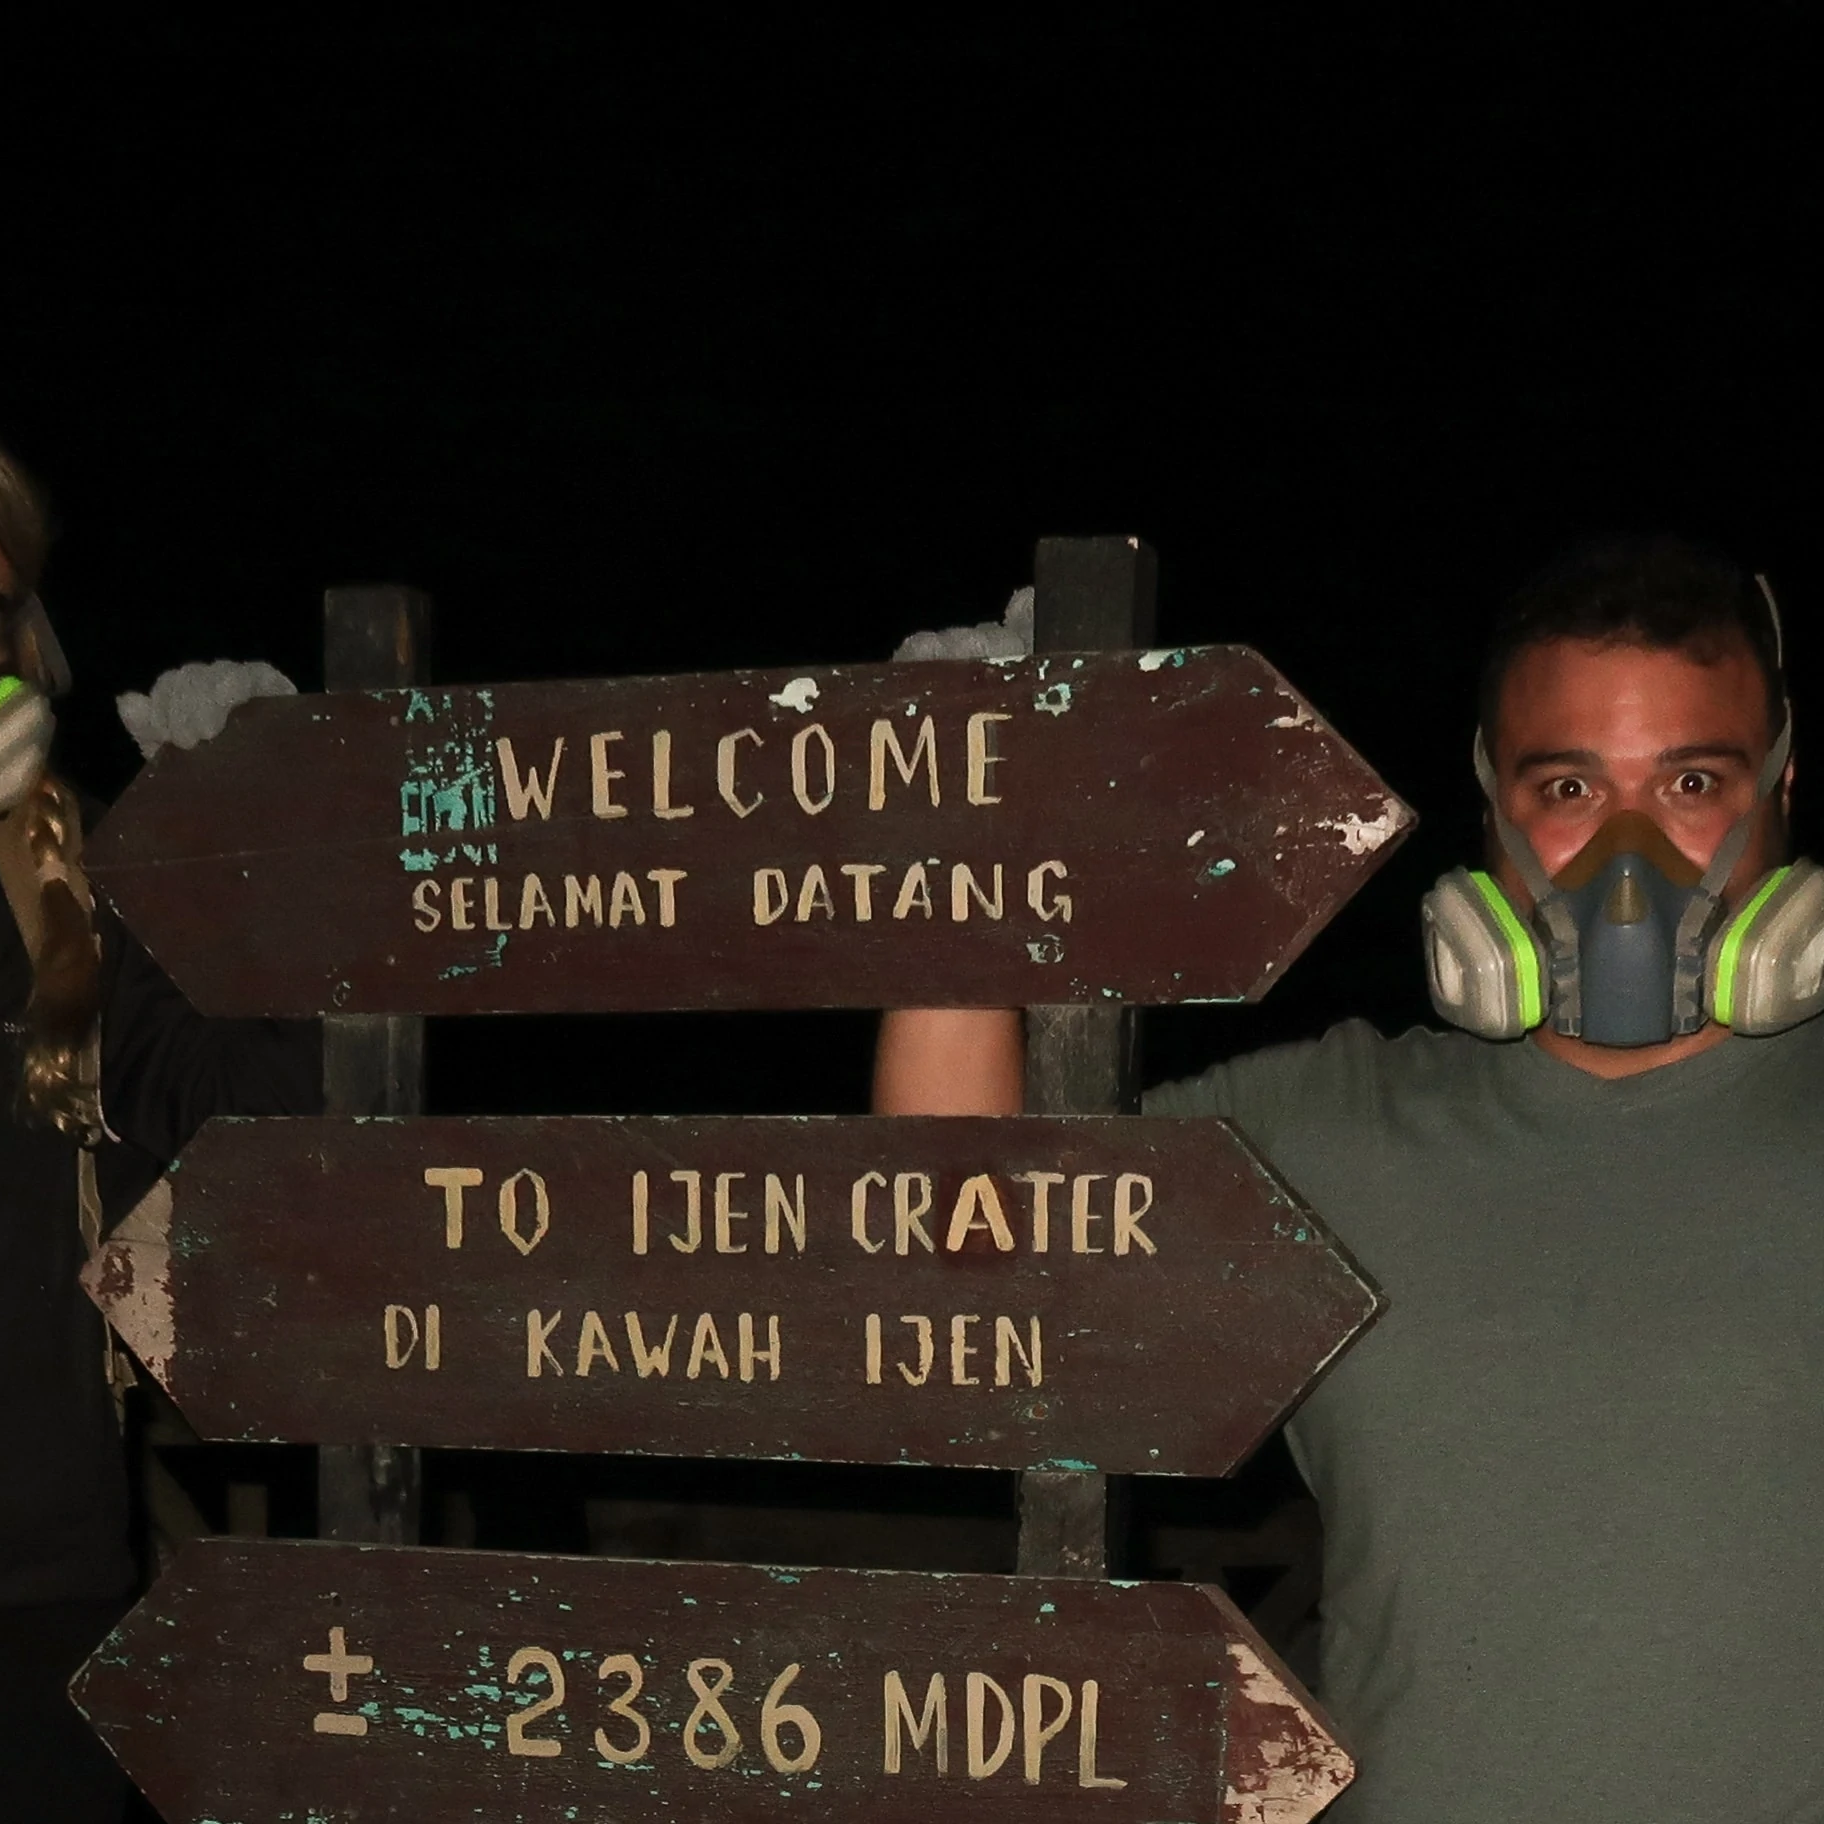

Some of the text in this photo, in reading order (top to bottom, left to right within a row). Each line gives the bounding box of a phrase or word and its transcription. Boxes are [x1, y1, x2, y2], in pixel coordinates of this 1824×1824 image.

[496, 711, 1012, 820] WELCOME
[413, 858, 1072, 932] SELAMAT DATANG
[425, 1168, 1157, 1256] TO IJEN CRATER
[384, 1304, 1042, 1387] DI KAWAH IJEN
[505, 1647, 821, 1772] 2386
[884, 1670, 1128, 1789] MDPL
